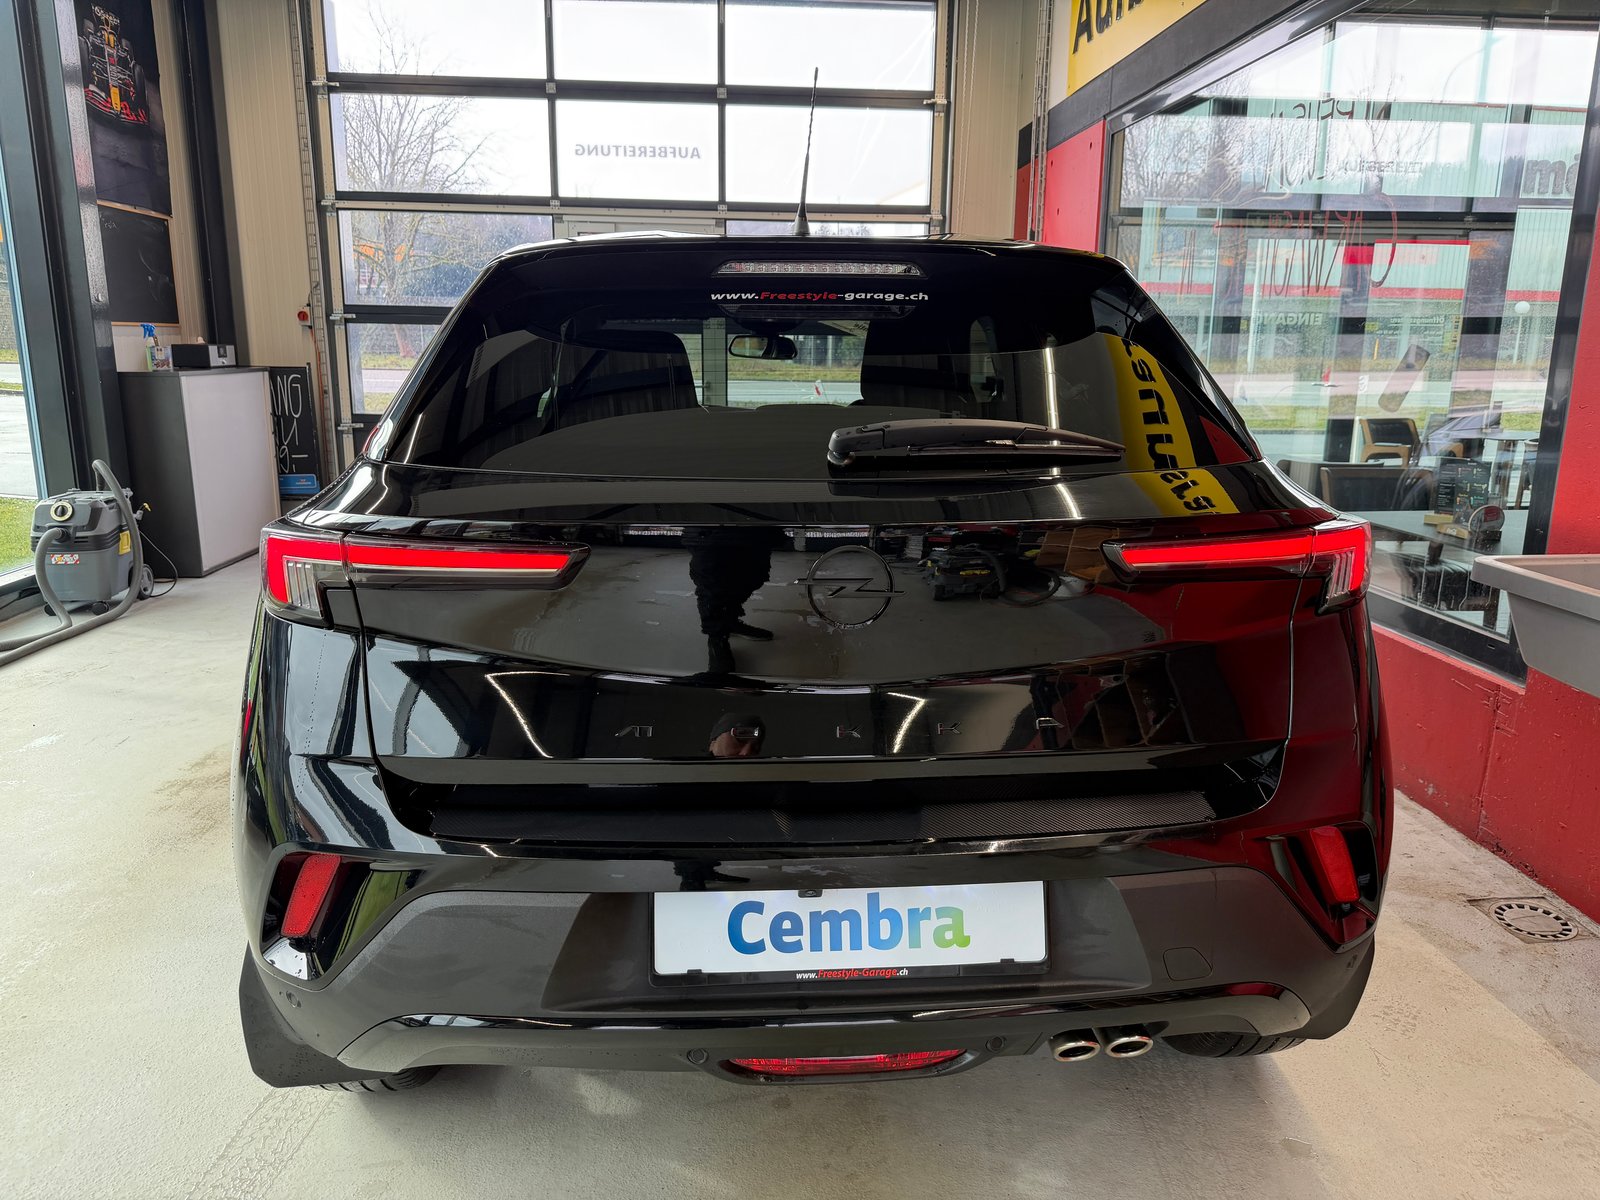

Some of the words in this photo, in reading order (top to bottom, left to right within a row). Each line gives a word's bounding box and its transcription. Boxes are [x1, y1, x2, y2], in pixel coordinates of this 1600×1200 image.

[710, 290, 929, 302] www.Freestyle-garage.ch
[727, 891, 971, 956] Cembra
[795, 967, 909, 980] www.Freestyle-Garage.ch
